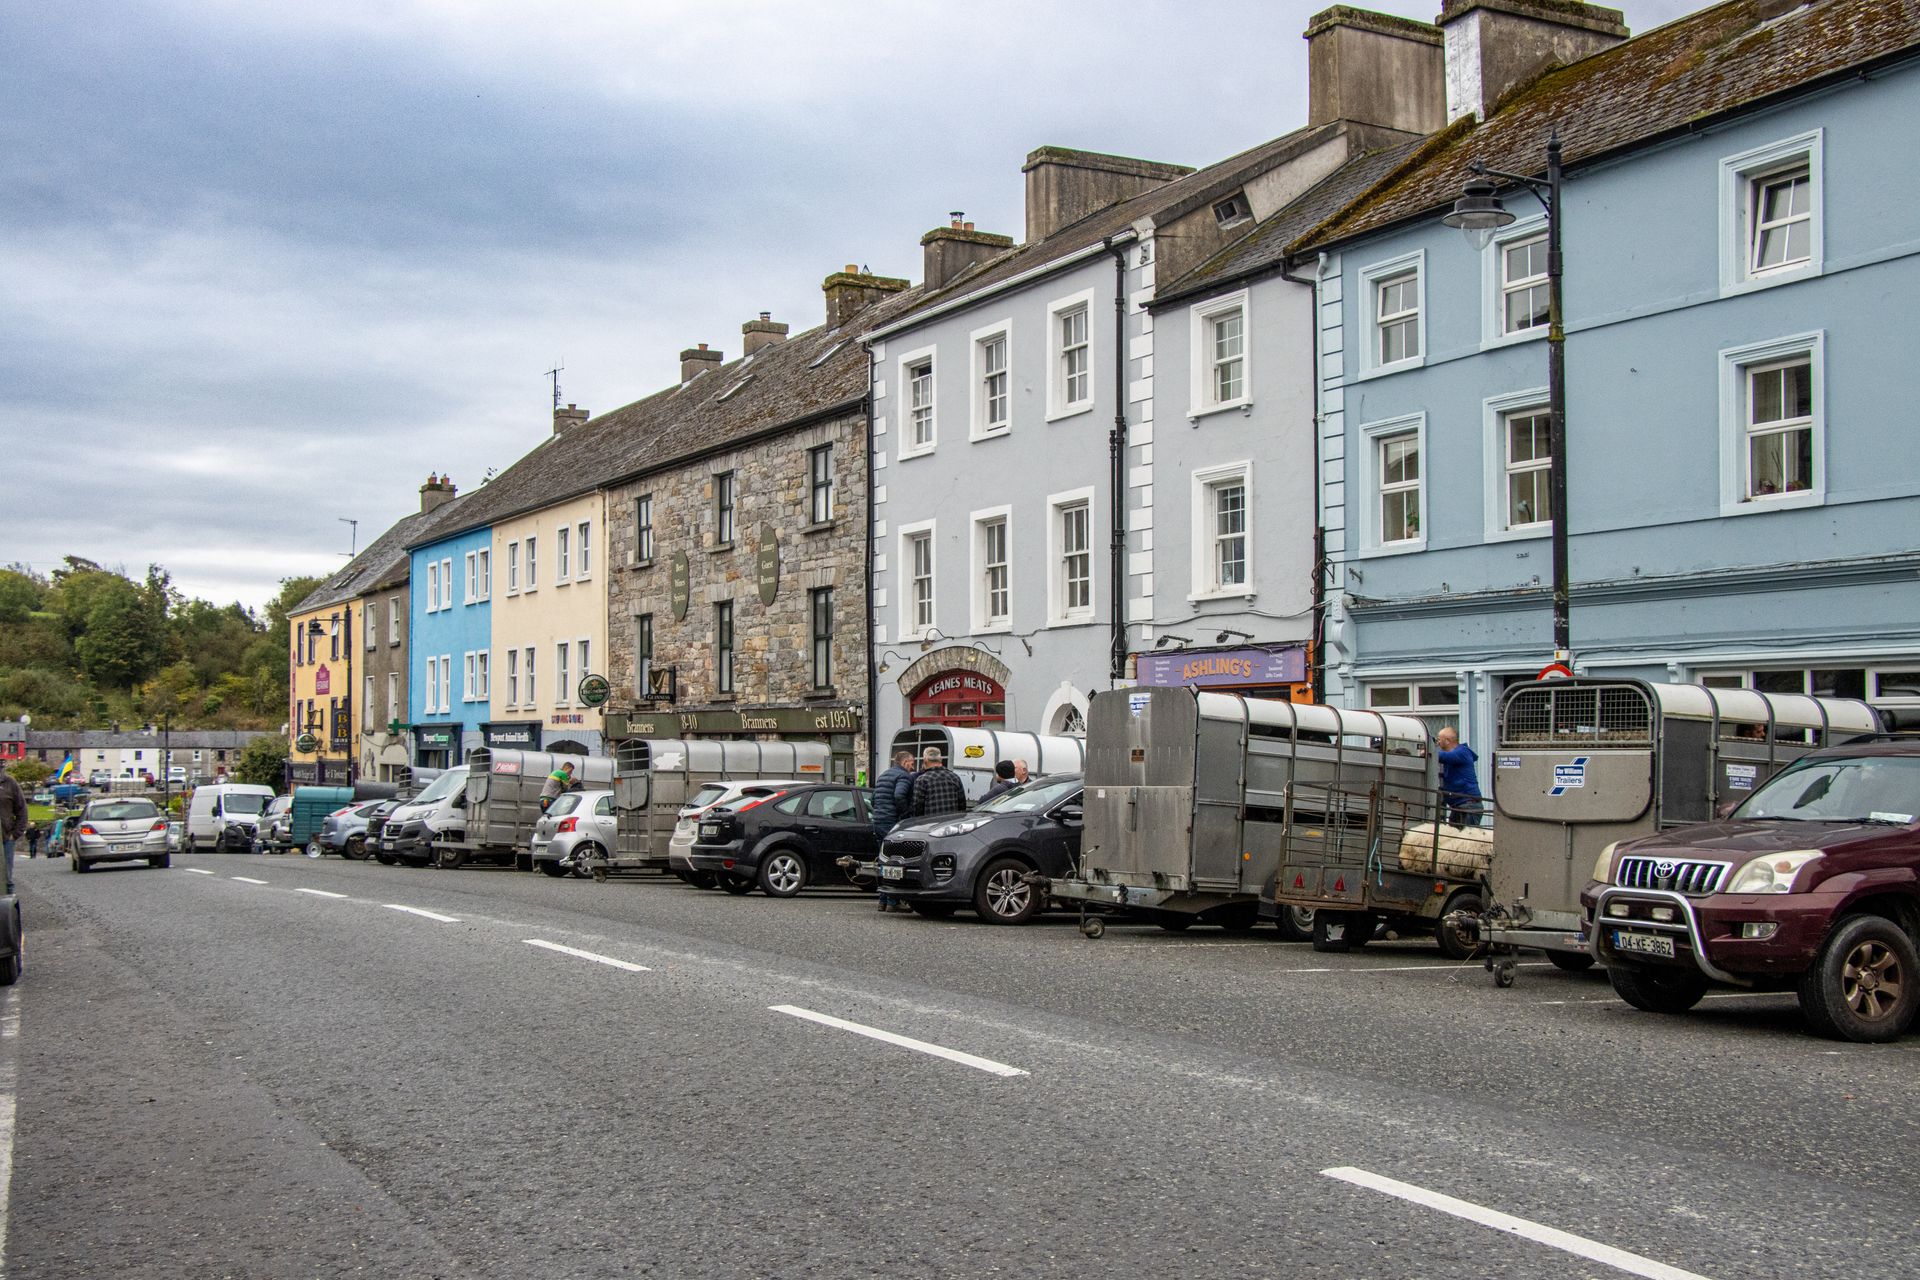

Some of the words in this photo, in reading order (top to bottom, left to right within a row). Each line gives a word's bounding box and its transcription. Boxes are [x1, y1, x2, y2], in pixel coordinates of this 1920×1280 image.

[760, 543, 775, 553] Luxury
[675, 563, 684, 572] Beer
[761, 561, 774, 570] Guest
[760, 575, 775, 585] Rooms
[1183, 657, 1252, 681] ASHLING'S
[928, 677, 961, 698] KEANES
[963, 677, 993, 696] MEATS
[681, 715, 698, 730] 8-10
[741, 713, 778, 729] Brannens
[815, 715, 828, 729] est
[830, 710, 851, 728] 1951
[626, 720, 655, 734] Brannens
[1557, 776, 1582, 784] Trailers
[1621, 935, 1673, 956] 04-KE-3862
